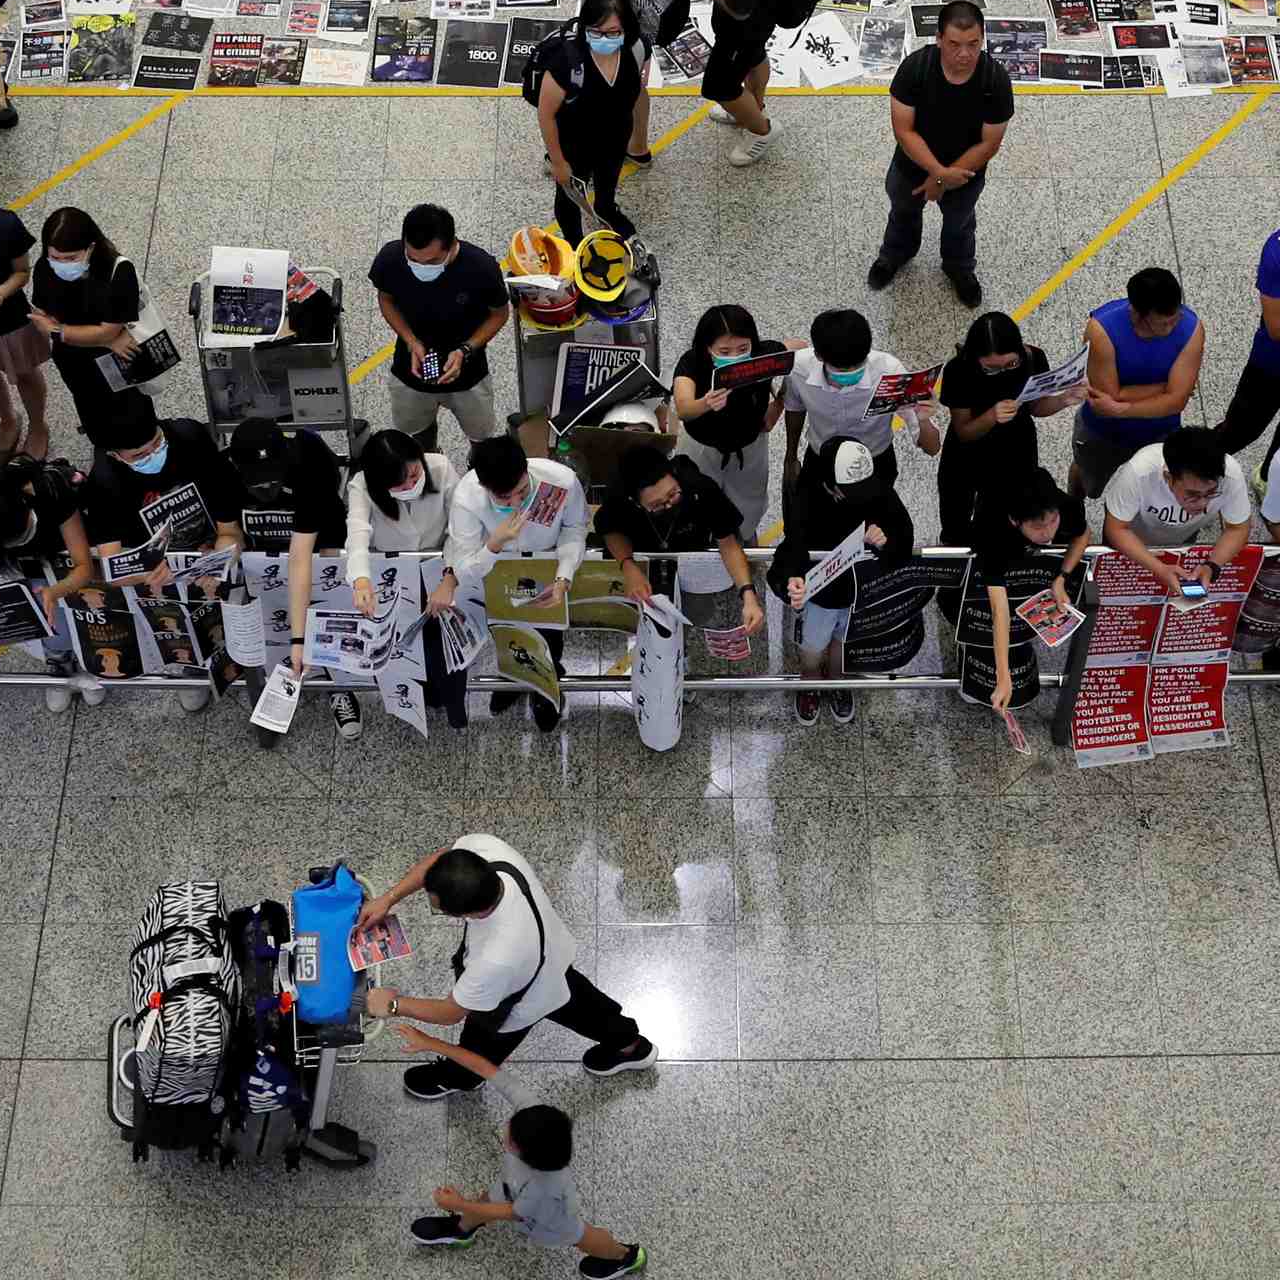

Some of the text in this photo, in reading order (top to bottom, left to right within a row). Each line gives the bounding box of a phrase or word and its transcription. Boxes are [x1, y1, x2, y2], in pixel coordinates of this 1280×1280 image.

[468, 50, 498, 61] 1800
[588, 349, 640, 367] WITNESS
[293, 387, 340, 396] KOHLER
[163, 489, 196, 510] POLICE
[265, 515, 294, 524] POLIC
[113, 553, 141, 565] THEY
[75, 609, 107, 625] SOS
[1091, 669, 1126, 677] POLICE
[1170, 666, 1205, 674] POLICE
[1102, 682, 1121, 691] GAS
[1074, 698, 1128, 708] NO MATTER
[1152, 695, 1192, 705] YOU ARE
[1075, 706, 1115, 717] YOU ARE
[1152, 702, 1210, 714] PROTESTERS
[1076, 713, 1133, 727] PROTESTERS
[1152, 709, 1217, 723] RESIDENTS OR
[1076, 722, 1141, 736] RESIDENTS OR
[1153, 719, 1213, 733] PASSENGERS
[1077, 732, 1137, 746] PASSENGERS
